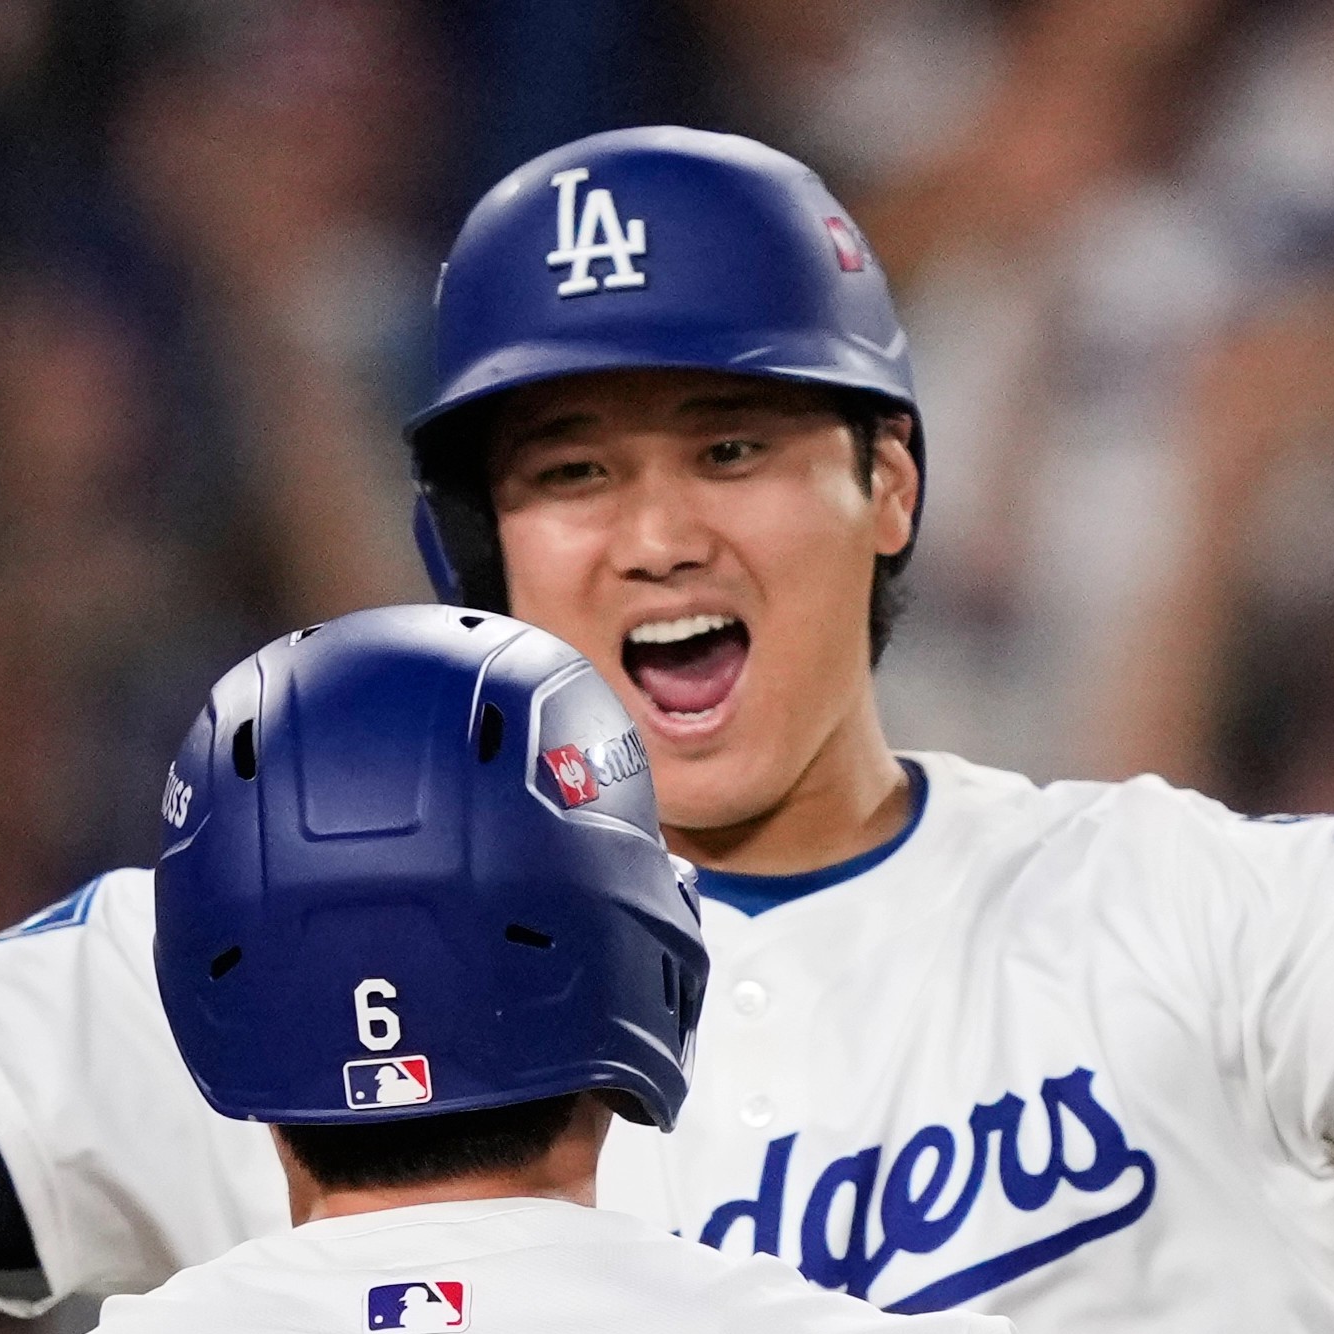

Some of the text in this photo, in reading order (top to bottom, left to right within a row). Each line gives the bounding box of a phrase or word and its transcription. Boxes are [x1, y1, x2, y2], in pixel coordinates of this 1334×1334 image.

[547, 167, 646, 297] LA
[354, 978, 400, 1051] 6
[669, 1067, 1156, 1315] dgers
